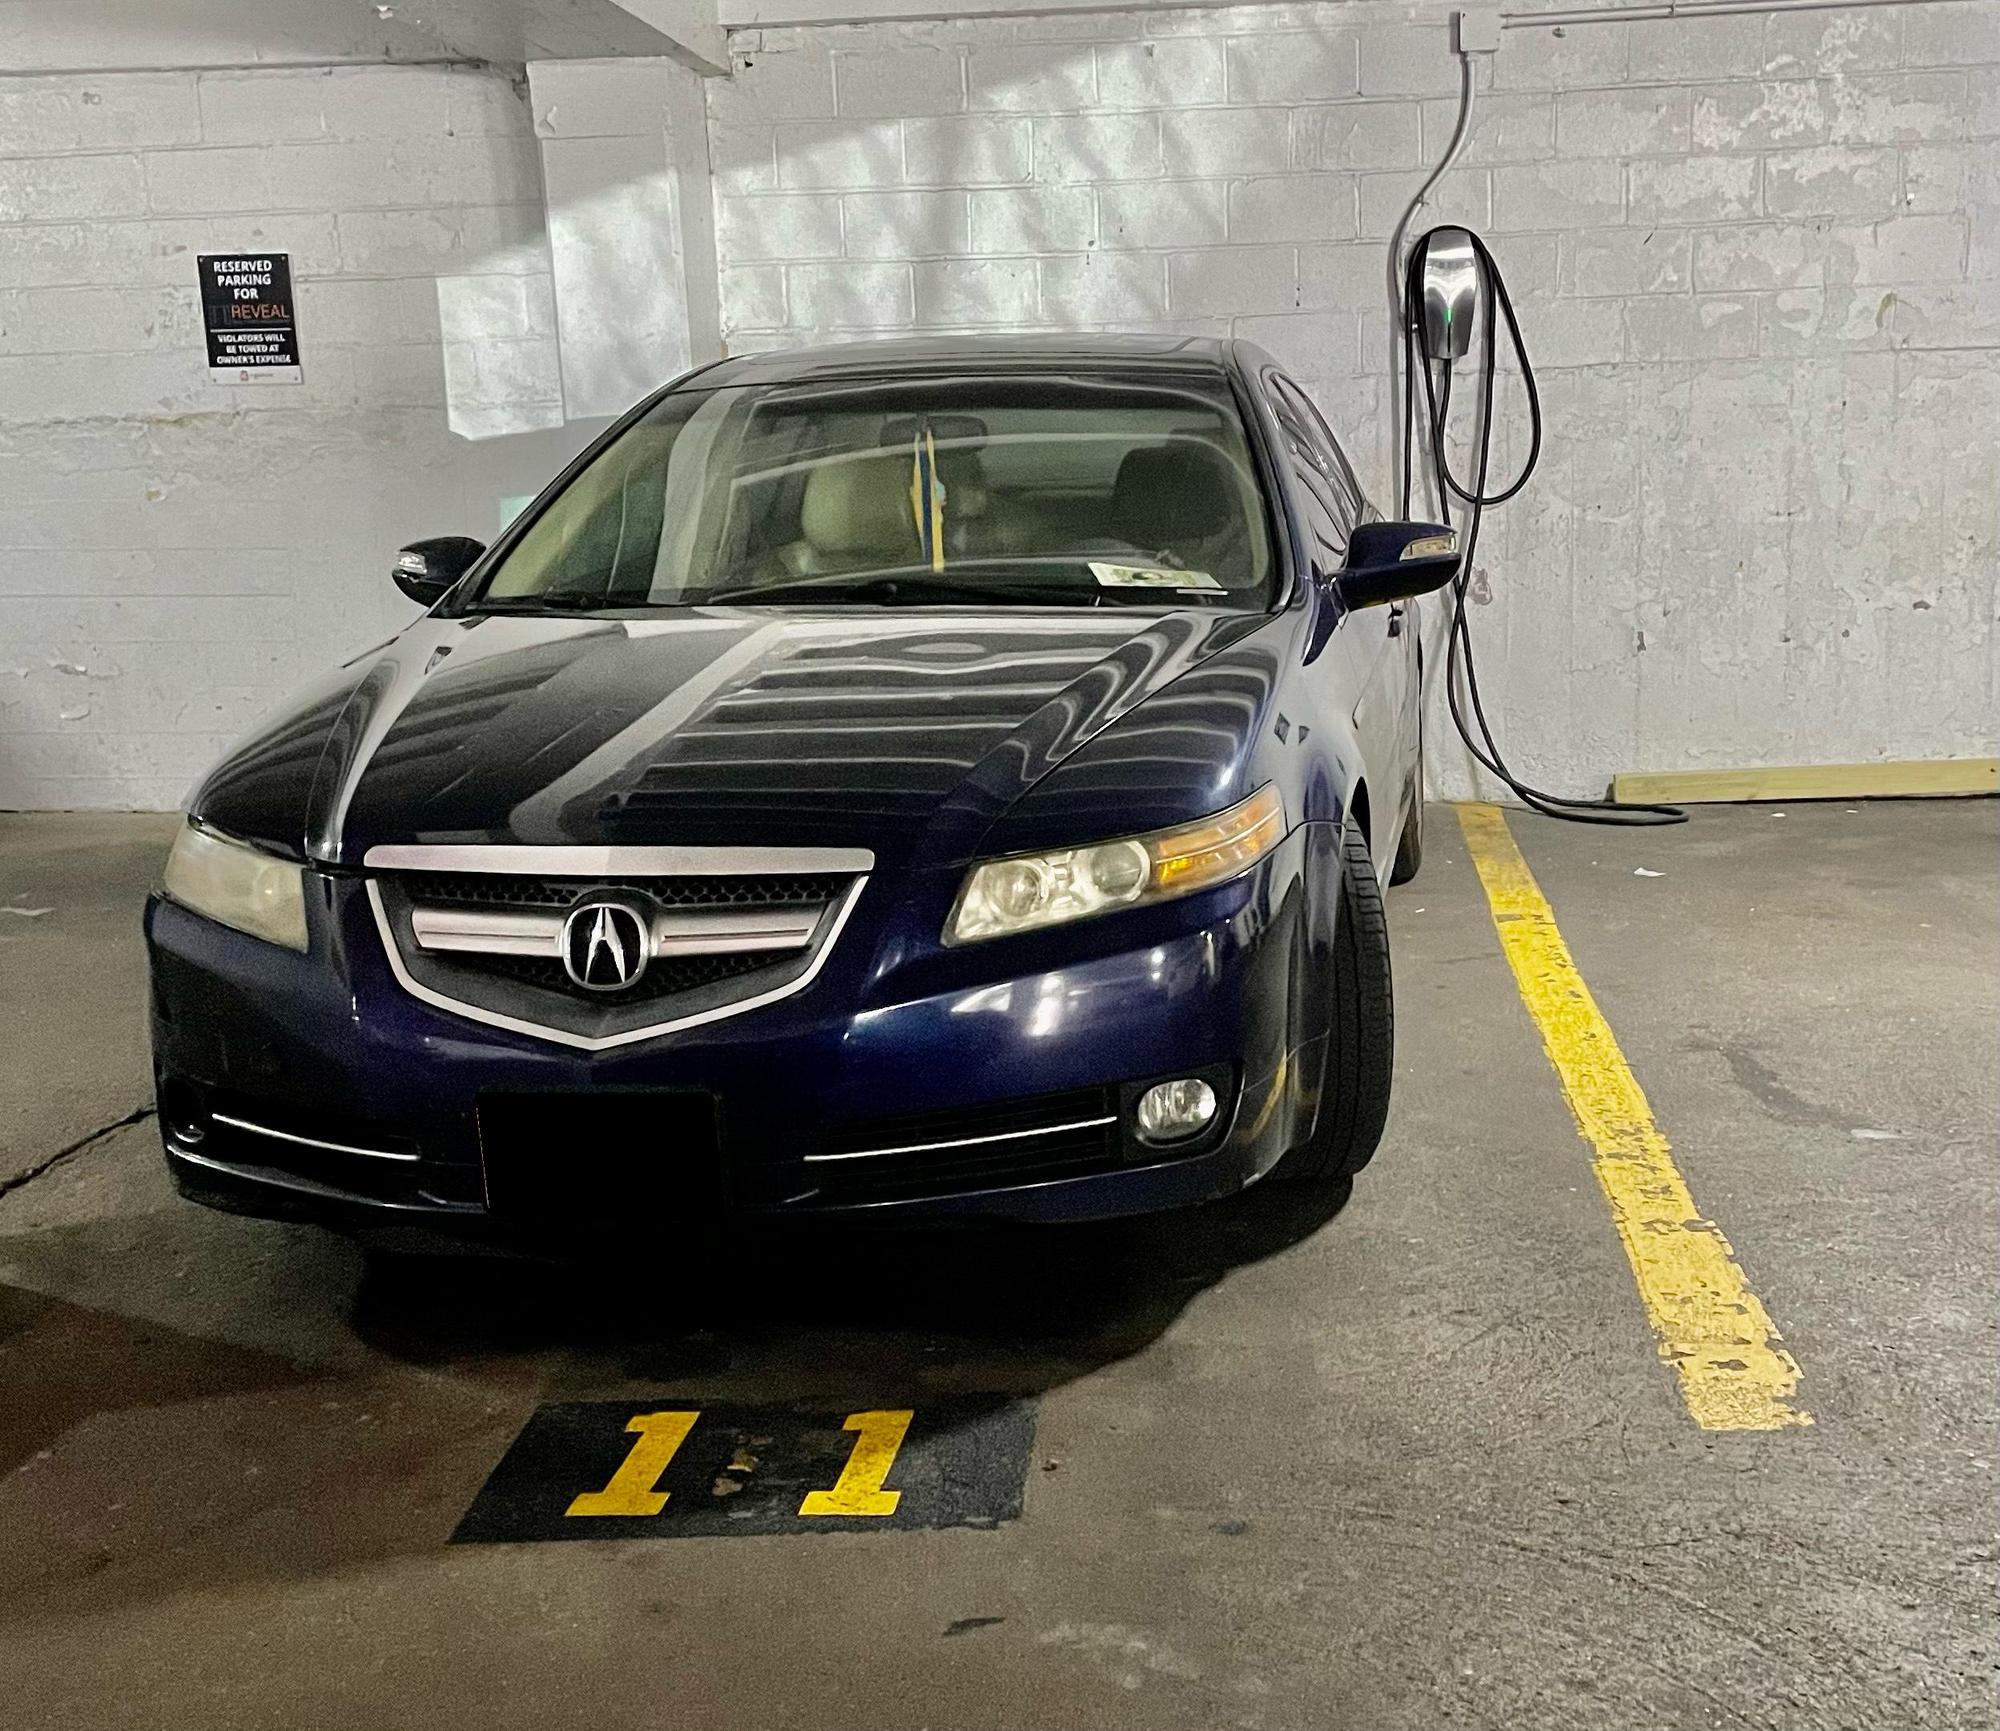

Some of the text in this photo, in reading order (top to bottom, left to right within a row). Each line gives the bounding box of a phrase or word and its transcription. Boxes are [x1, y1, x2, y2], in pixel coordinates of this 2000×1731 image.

[213, 260, 272, 273] RESERVED
[217, 273, 271, 287] PARKING
[233, 287, 259, 300] FOR
[231, 304, 290, 319] REVEAL
[217, 333, 286, 343] VIOLATORS WILL
[238, 344, 268, 353] TOWED
[269, 344, 279, 352] AT
[216, 355, 255, 364] OWNER'S
